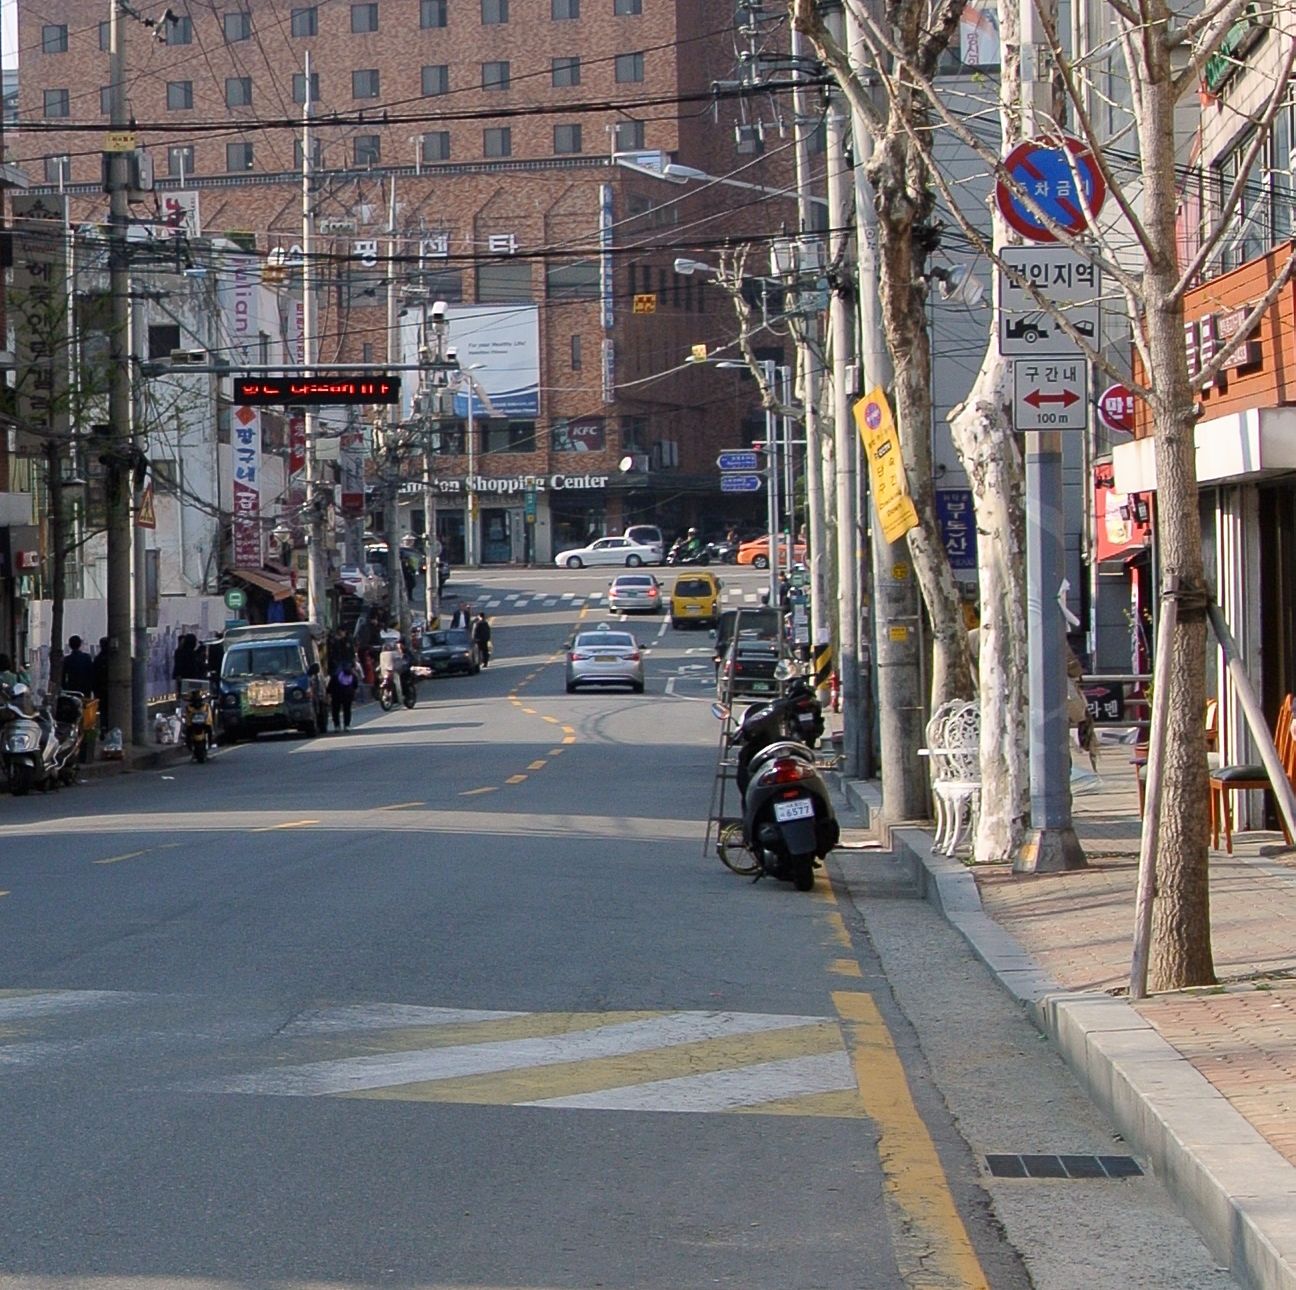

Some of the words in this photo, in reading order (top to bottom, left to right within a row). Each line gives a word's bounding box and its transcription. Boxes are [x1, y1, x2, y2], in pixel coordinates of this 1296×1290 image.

[1007, 262, 1095, 289] 견인지역
[1037, 413, 1057, 423] 100
[1059, 414, 1069, 423] m
[573, 426, 598, 435] KFC
[465, 475, 545, 494] Shoppig
[550, 476, 609, 490] Center
[945, 502, 968, 556] 부동산
[1086, 699, 1119, 719] 라멘
